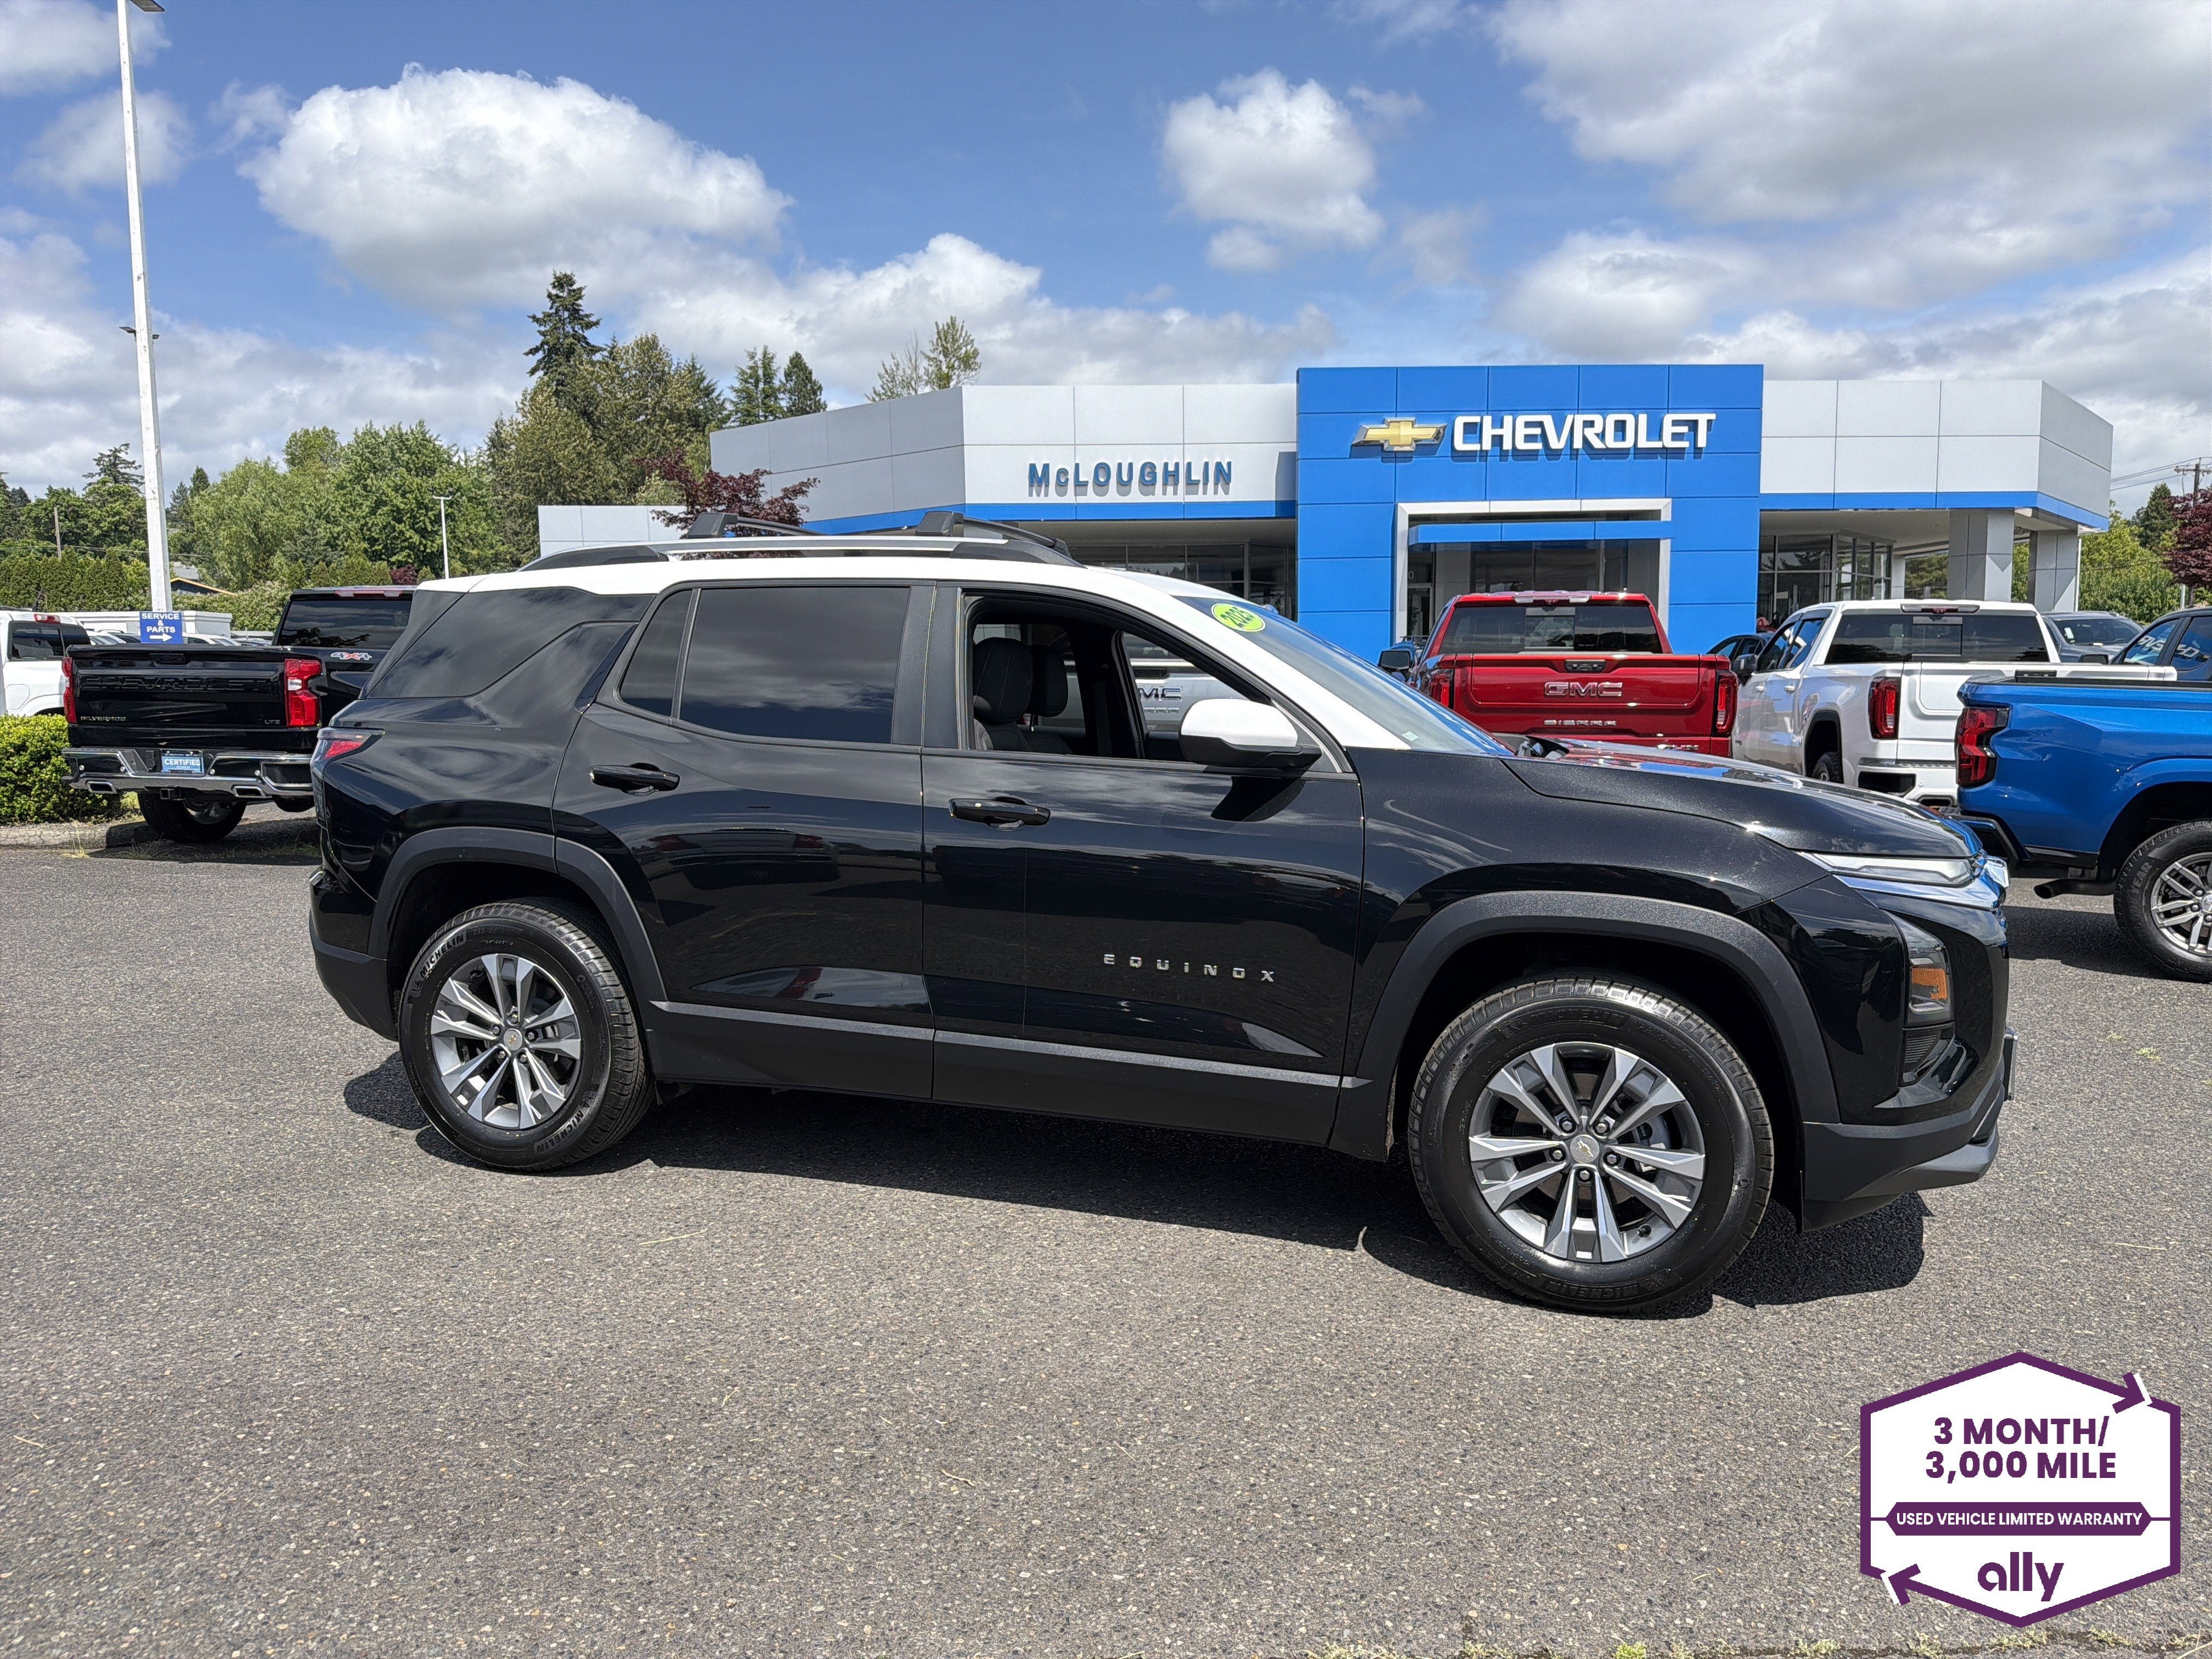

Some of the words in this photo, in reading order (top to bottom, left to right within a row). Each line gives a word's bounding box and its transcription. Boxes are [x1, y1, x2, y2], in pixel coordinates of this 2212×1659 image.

[1453, 413, 1716, 451] CHEVROLET
[1028, 461, 1232, 486] McLOUGHLIN
[1220, 606, 1255, 629] 2025
[1139, 686, 1183, 702] MC
[1544, 681, 1623, 697] GMC
[164, 758, 201, 766] CERTIFIED
[420, 932, 465, 980] MICHELIN
[1103, 954, 1274, 982] EQUINOX
[537, 1109, 584, 1151] MICHELIN
